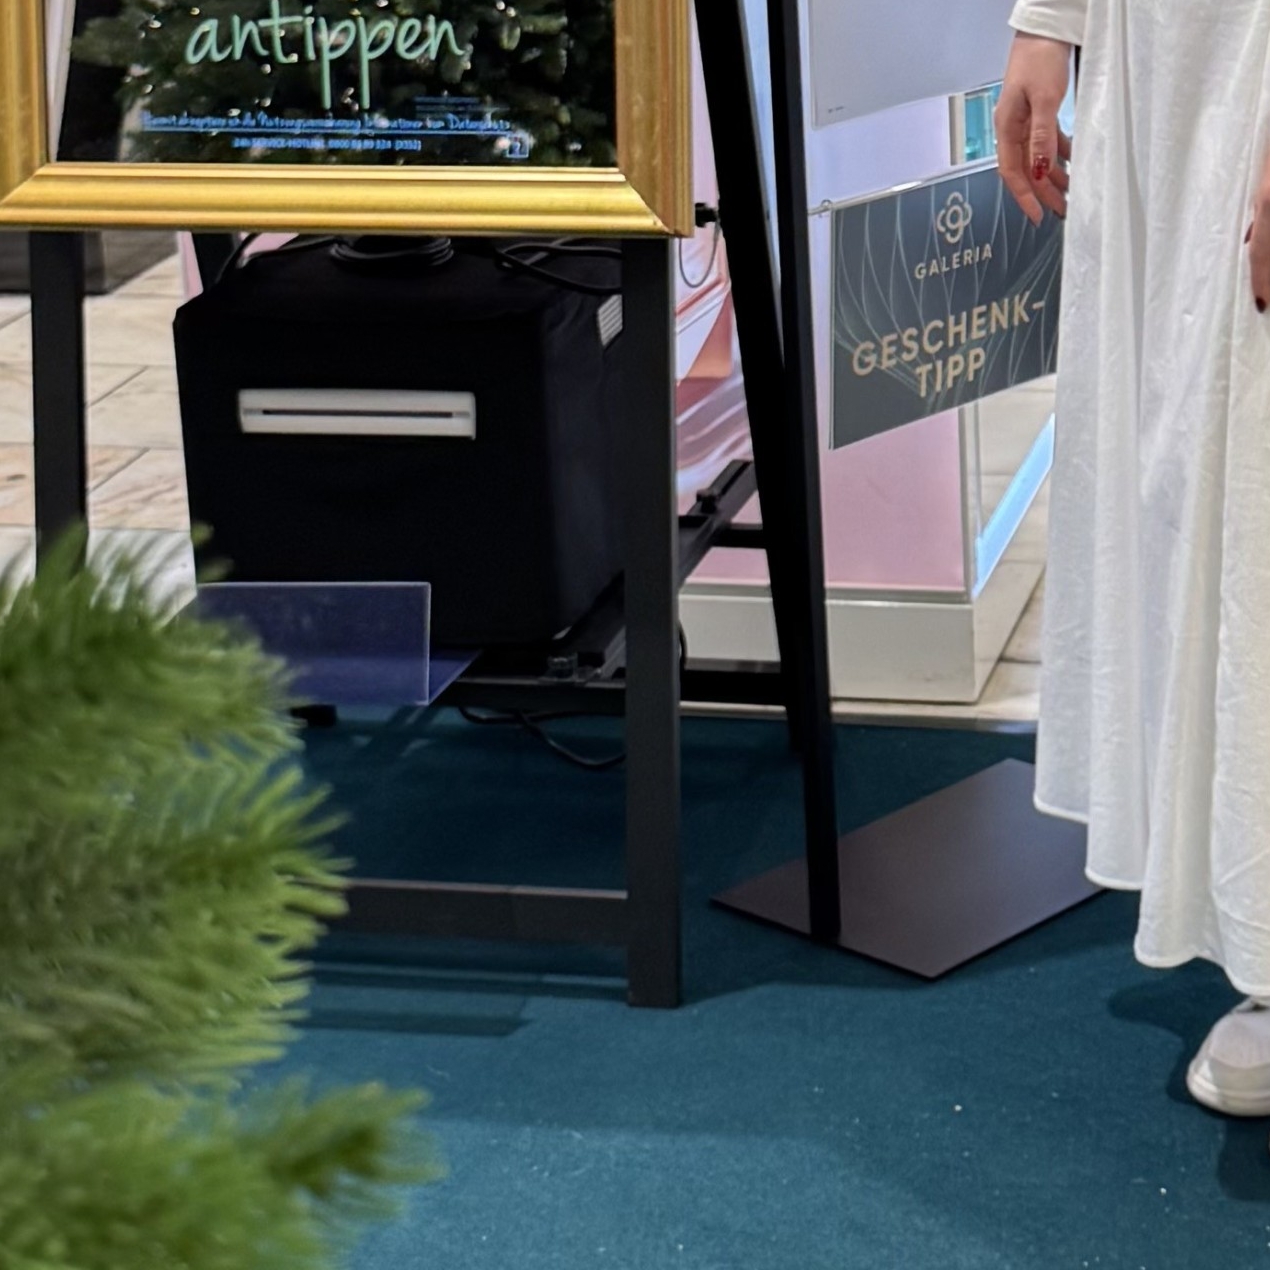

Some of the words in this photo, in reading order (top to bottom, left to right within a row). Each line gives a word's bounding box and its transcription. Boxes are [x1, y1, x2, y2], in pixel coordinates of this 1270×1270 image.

[914, 243, 993, 280] GALERIA
[852, 290, 1046, 376] GESCHENK-
[916, 347, 987, 398] TIPP
